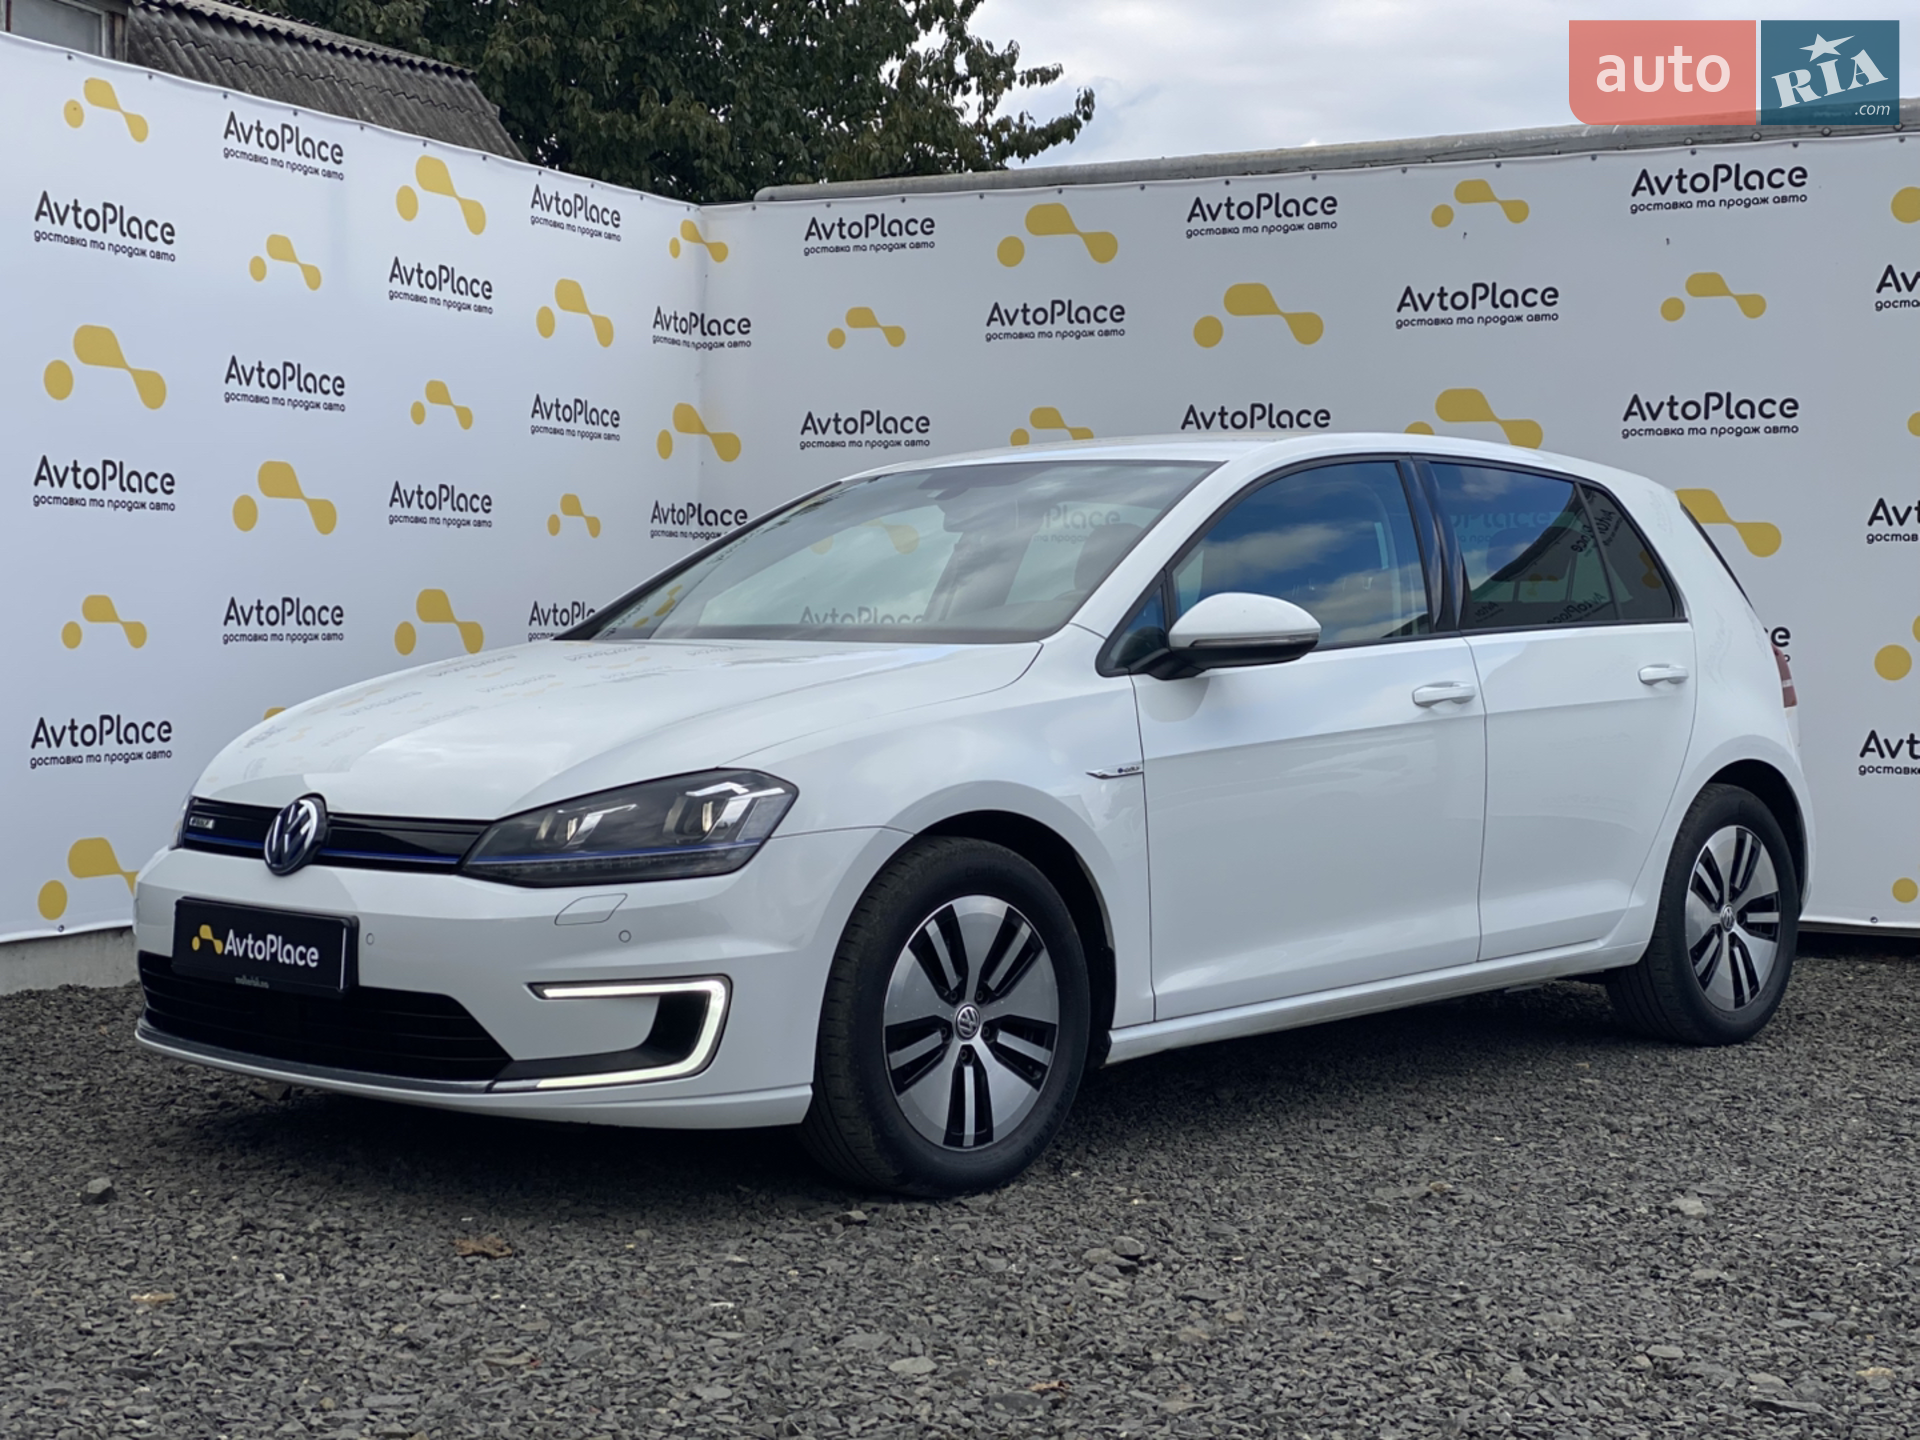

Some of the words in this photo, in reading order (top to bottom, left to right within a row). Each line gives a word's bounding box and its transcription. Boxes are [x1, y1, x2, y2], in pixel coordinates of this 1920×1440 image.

[224, 111, 343, 165] AvtoPlace
[223, 147, 268, 165] доставка
[271, 158, 284, 168] та
[286, 161, 320, 176] продаж
[321, 169, 344, 181] авто
[1631, 163, 1808, 197] AvtoPlace
[35, 190, 175, 245] AvtoPlace
[531, 184, 620, 228] AvtoPlace
[1187, 192, 1338, 223] AvtoPlace
[1630, 200, 1693, 214] доставка
[1696, 200, 1716, 208] та
[1719, 197, 1769, 209] продаж
[1772, 194, 1808, 204] авто
[804, 213, 935, 241] AvtoPlace
[1186, 226, 1240, 239] доставка
[1261, 224, 1304, 234] продаж
[1307, 221, 1338, 230] авто
[34, 230, 87, 247] доставка
[90, 240, 106, 250] та
[108, 243, 147, 258] продаж
[149, 250, 176, 262] авто
[804, 245, 850, 256] доставка
[853, 244, 867, 252] та
[869, 242, 906, 252] продаж
[909, 241, 935, 249] авто
[389, 256, 492, 300] AvtoPlace
[1397, 282, 1559, 312] AvtoPlace
[653, 306, 751, 336] AvtoPlace
[986, 300, 1125, 327] AvtoPlace
[1396, 317, 1454, 330] доставка
[1456, 316, 1474, 324] та
[1477, 315, 1523, 326] продаж
[1526, 313, 1559, 322] авто
[985, 332, 1035, 342] доставка
[1055, 330, 1095, 340] продаж
[1097, 329, 1125, 337] авто
[225, 355, 345, 396] AvtoPlace
[224, 392, 270, 404] доставка
[272, 397, 285, 406] та
[287, 398, 321, 411] продаж
[322, 402, 346, 412] авто
[531, 394, 620, 428] AvtoPlace
[1181, 403, 1331, 430] AvtoPlace
[1623, 392, 1799, 422] AvtoPlace
[800, 410, 930, 435] AvtoPlace
[1622, 428, 1684, 439] доставка
[1688, 427, 1707, 435] та
[1710, 426, 1760, 437] продаж
[1764, 425, 1799, 434] авто
[800, 440, 846, 450] доставка
[848, 440, 863, 448] та
[865, 440, 902, 449] продаж
[34, 455, 175, 495] AvtoPlace
[33, 495, 86, 507] доставка
[89, 498, 105, 508] та
[107, 499, 146, 512] продаж
[149, 502, 175, 512] авто
[389, 481, 492, 514] AvtoPlace
[651, 500, 748, 526] AvtoPlace
[224, 597, 344, 626] AvtoPlace
[223, 633, 268, 645] доставка
[270, 633, 284, 642] та
[286, 633, 319, 644] продаж
[321, 633, 344, 641] авто
[31, 714, 172, 749] AvtoPlace
[30, 755, 83, 770] доставка
[86, 754, 102, 763] та
[104, 752, 143, 764] продаж
[146, 750, 172, 760] авто
[224, 929, 320, 968] AvtoPlace
